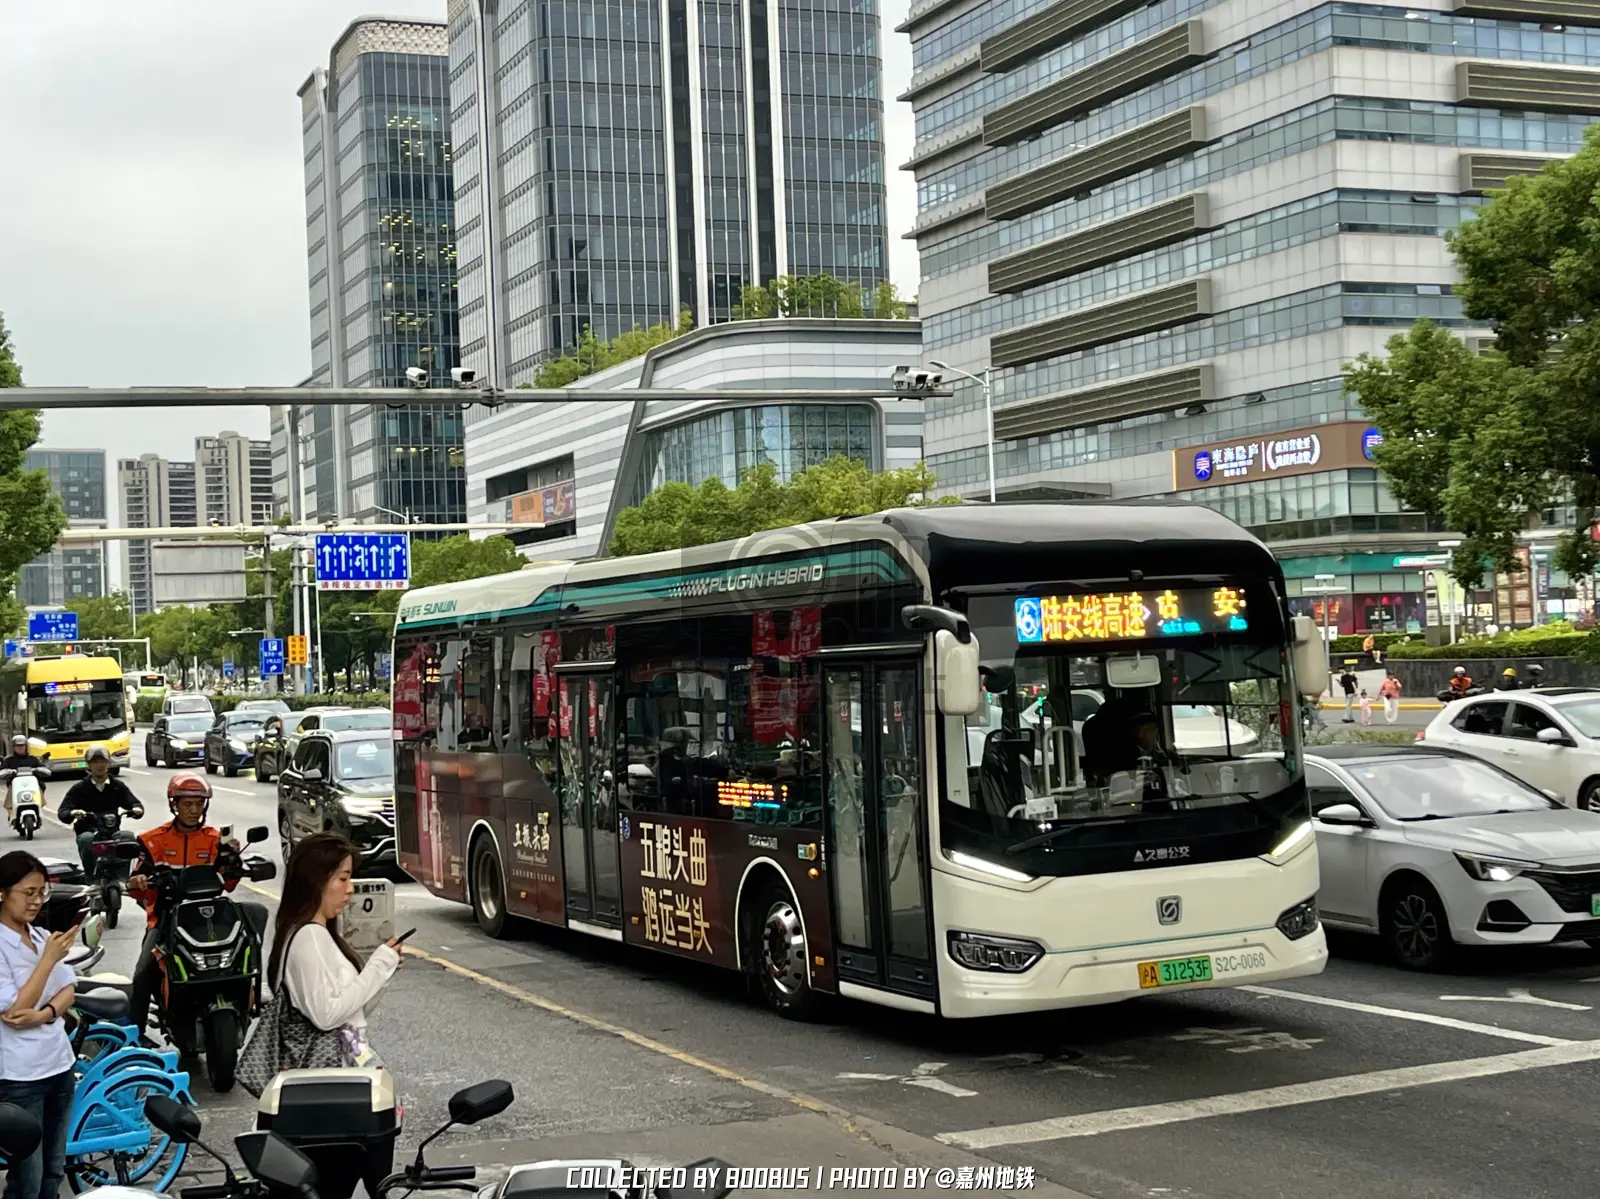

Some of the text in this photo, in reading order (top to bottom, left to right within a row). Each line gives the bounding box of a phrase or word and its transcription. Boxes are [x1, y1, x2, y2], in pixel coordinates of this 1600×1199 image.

[708, 564, 823, 593] PLUG-IN HYBRID
[423, 600, 458, 615] SUNWIN
[1040, 591, 1146, 642] 陆安线高速
[639, 822, 708, 887] 五粮头曲
[363, 897, 373, 913] 0
[641, 887, 713, 955] 鸿运当头
[1215, 951, 1266, 973] S2C-0068
